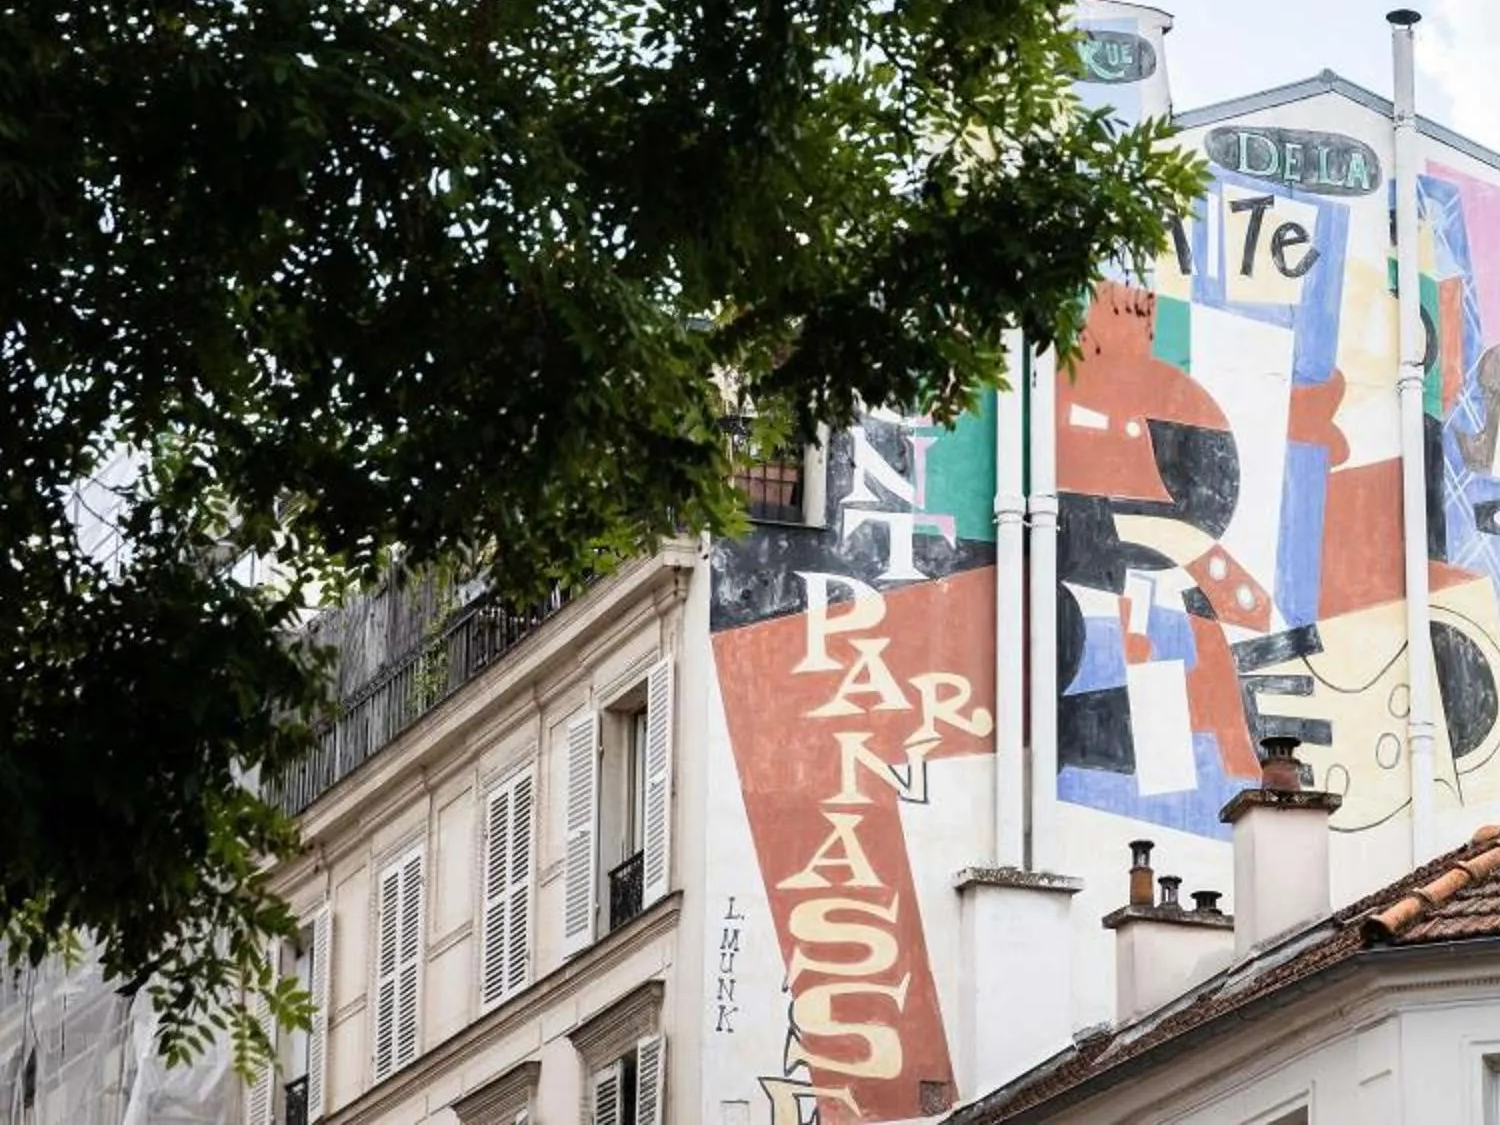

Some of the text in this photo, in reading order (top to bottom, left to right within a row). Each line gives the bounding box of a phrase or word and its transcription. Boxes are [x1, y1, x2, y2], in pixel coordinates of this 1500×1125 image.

[1237, 132, 1371, 191] DE LA
[715, 927, 741, 1034] MUNK
